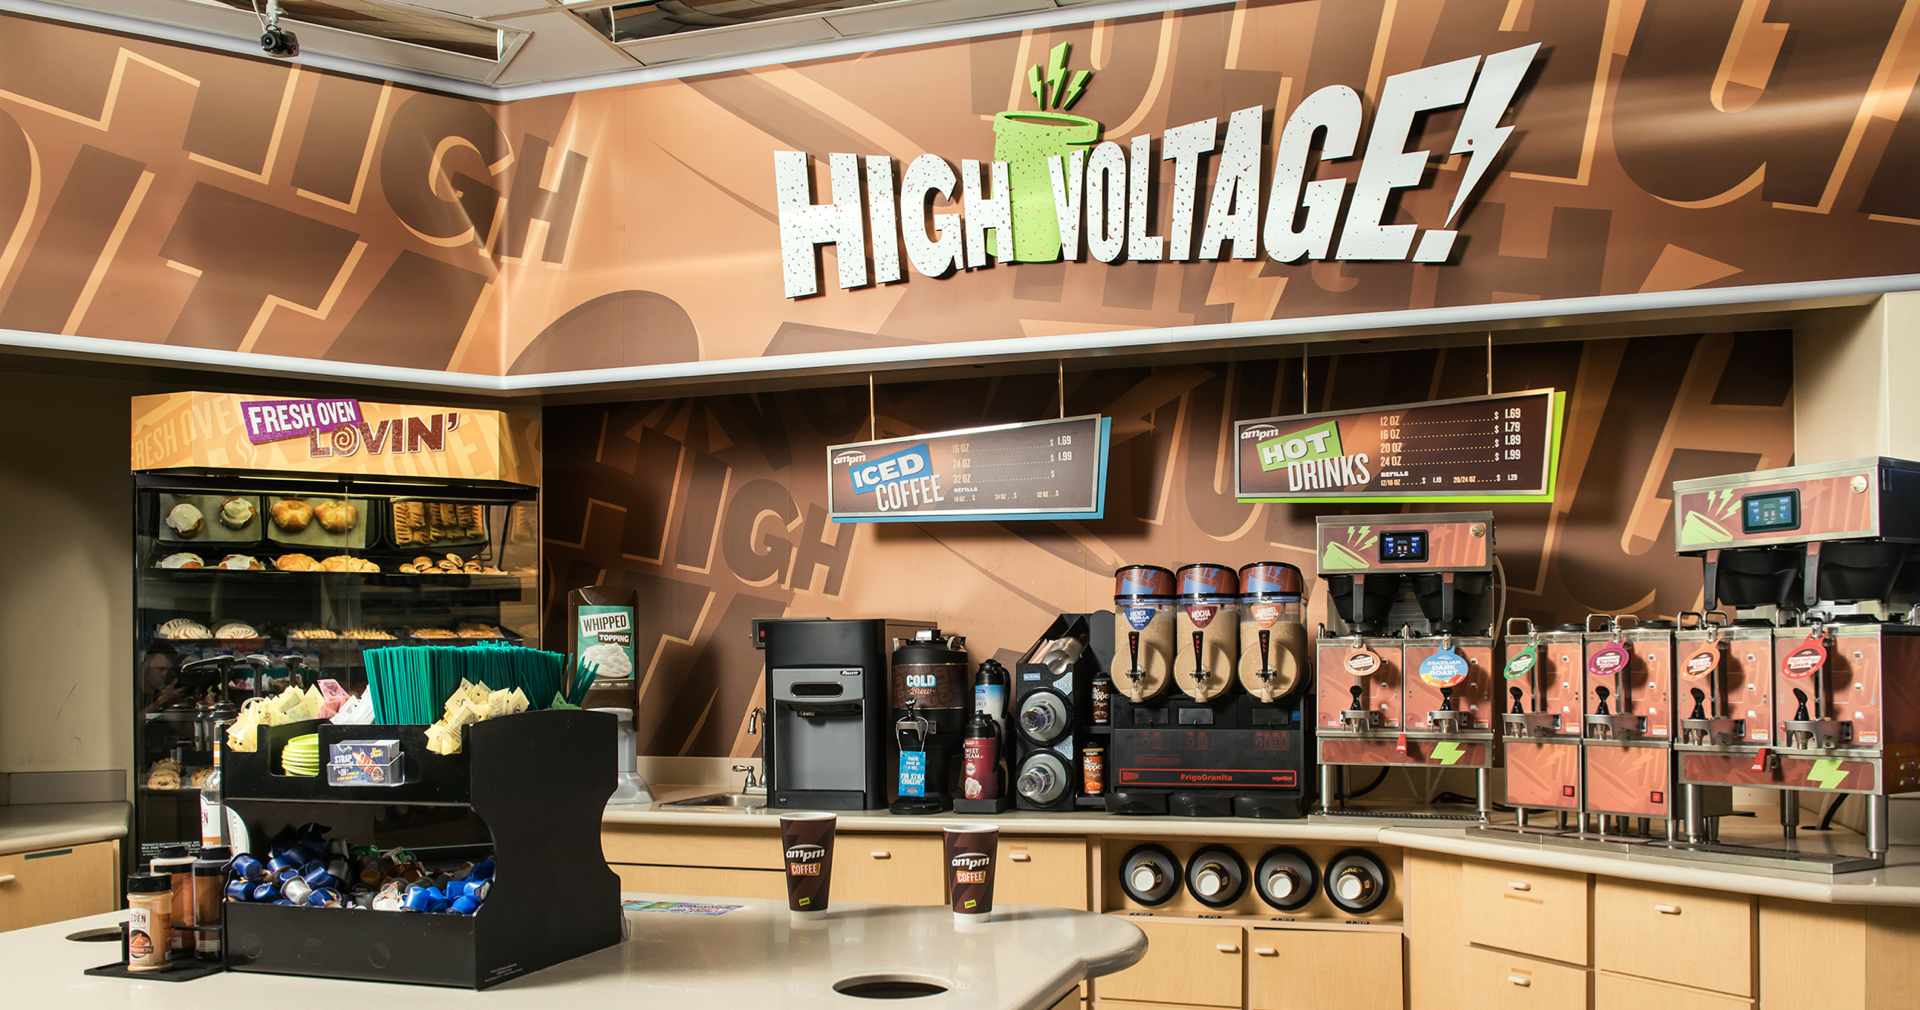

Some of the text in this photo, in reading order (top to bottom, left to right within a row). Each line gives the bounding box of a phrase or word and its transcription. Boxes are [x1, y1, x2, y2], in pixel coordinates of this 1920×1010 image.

[774, 42, 1542, 299] HIGH VOLTAGE!
[248, 401, 357, 435] FRESH OVEN
[1380, 408, 1522, 426] 12 OZ $ 1.69
[310, 412, 461, 458] LOVIN'
[1241, 424, 1279, 441] ampm
[1380, 422, 1521, 440] 16 OZ $ 1.79
[952, 443, 962, 454] 16
[962, 443, 970, 453] OZ
[1057, 435, 1072, 446] 1.69
[1262, 430, 1331, 465] HOT
[1380, 435, 1522, 454] 20 OZ $ 1.89
[833, 451, 867, 466] ampm
[952, 459, 962, 469] 24
[962, 458, 971, 468] OZ
[1058, 451, 1072, 462] 1.99
[1380, 450, 1522, 467] 24 OZ $ 1.99
[853, 453, 925, 488] ICED
[953, 474, 962, 484] 32
[962, 474, 972, 484] OZ
[1287, 453, 1371, 492] DRINKS
[875, 474, 944, 512] COFFEE
[1192, 610, 1211, 618] MOCHA
[583, 614, 627, 632] WHIPPED
[599, 634, 630, 643] TOPPING
[906, 674, 936, 688] COLD
[910, 687, 932, 695] Brew
[334, 754, 352, 763] STRAP
[1180, 773, 1233, 782] FrigoGranita
[786, 845, 825, 862] ampm
[952, 854, 990, 870] ampm
[791, 863, 818, 876] COFFEE
[957, 871, 984, 883] COFFEE
[131, 914, 146, 923] EDEN
